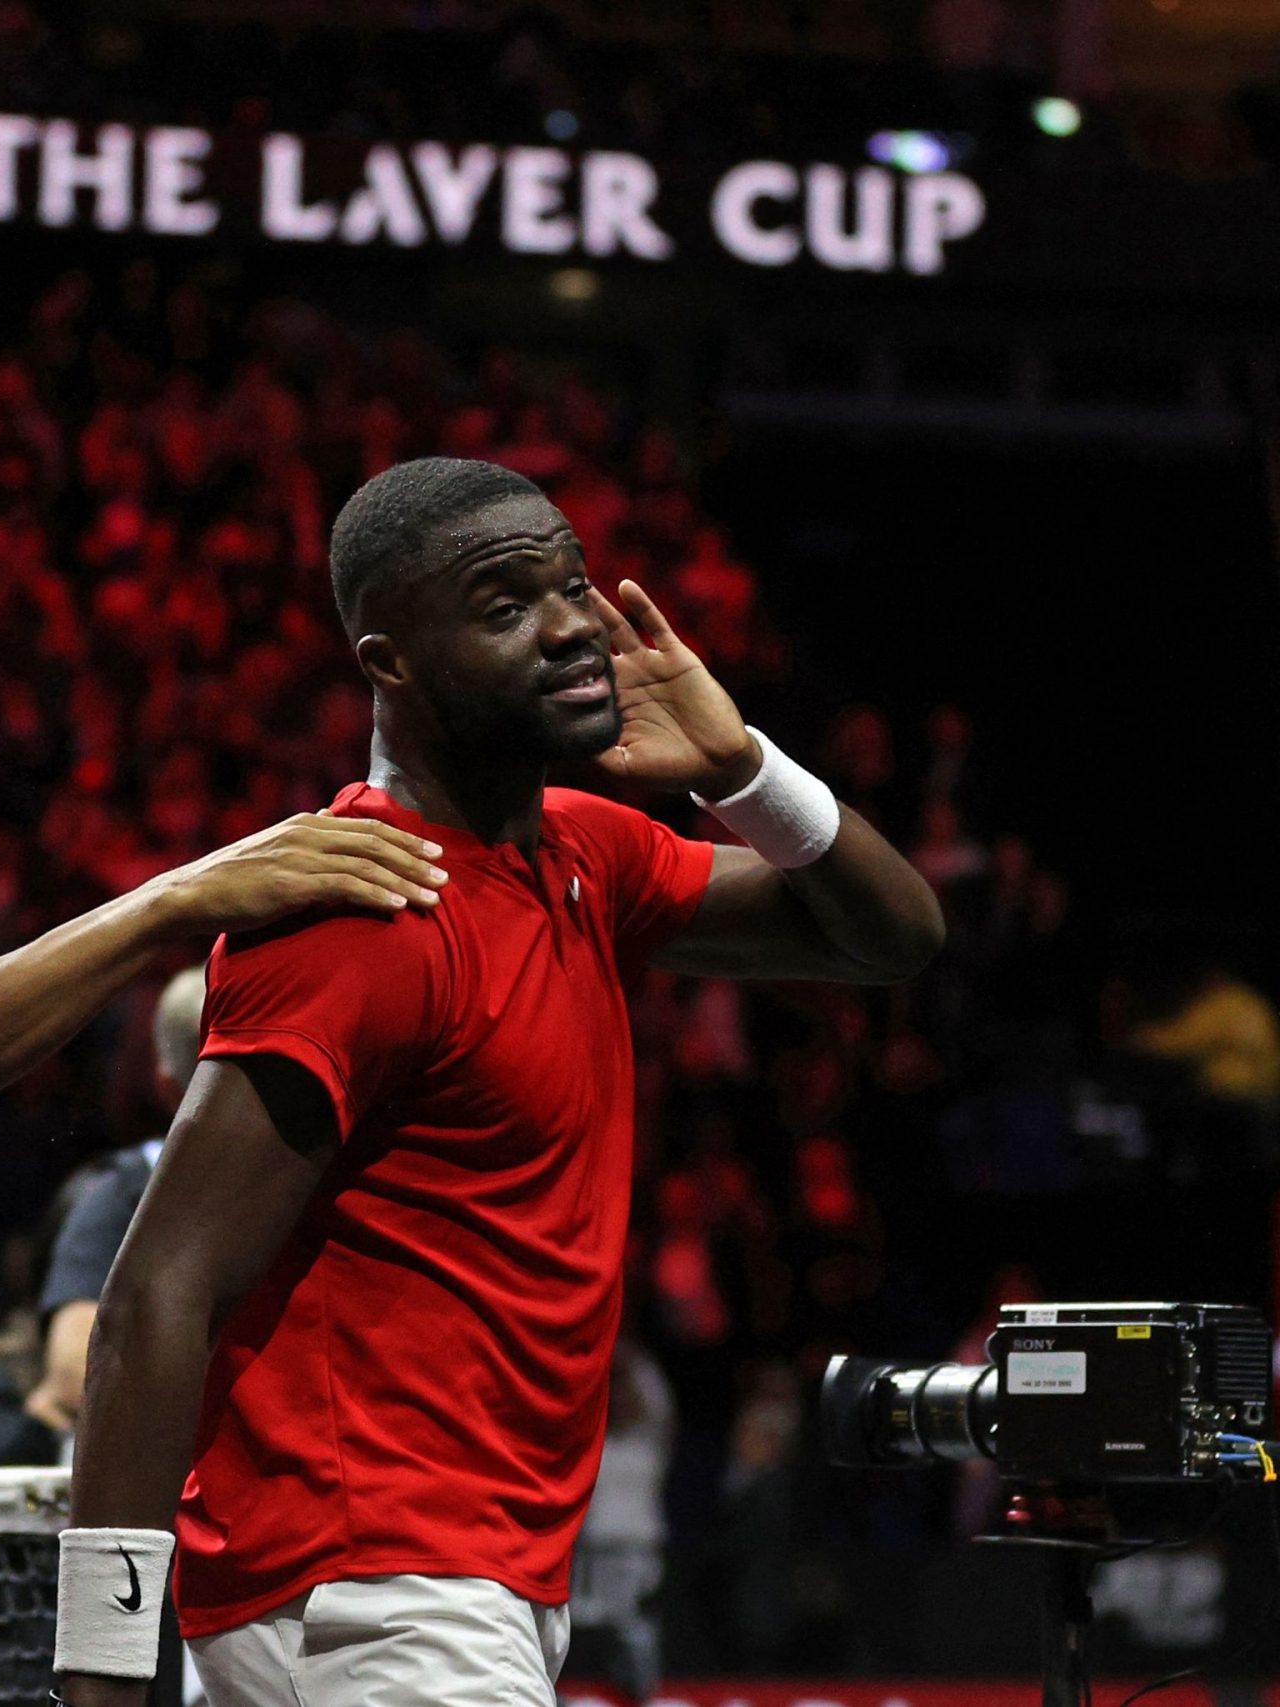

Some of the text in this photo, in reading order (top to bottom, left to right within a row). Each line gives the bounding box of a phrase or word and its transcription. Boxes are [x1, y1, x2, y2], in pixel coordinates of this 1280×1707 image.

[262, 135, 668, 258] LAVER
[712, 160, 984, 274] CUP
[1013, 1338, 1056, 1350] SONY
